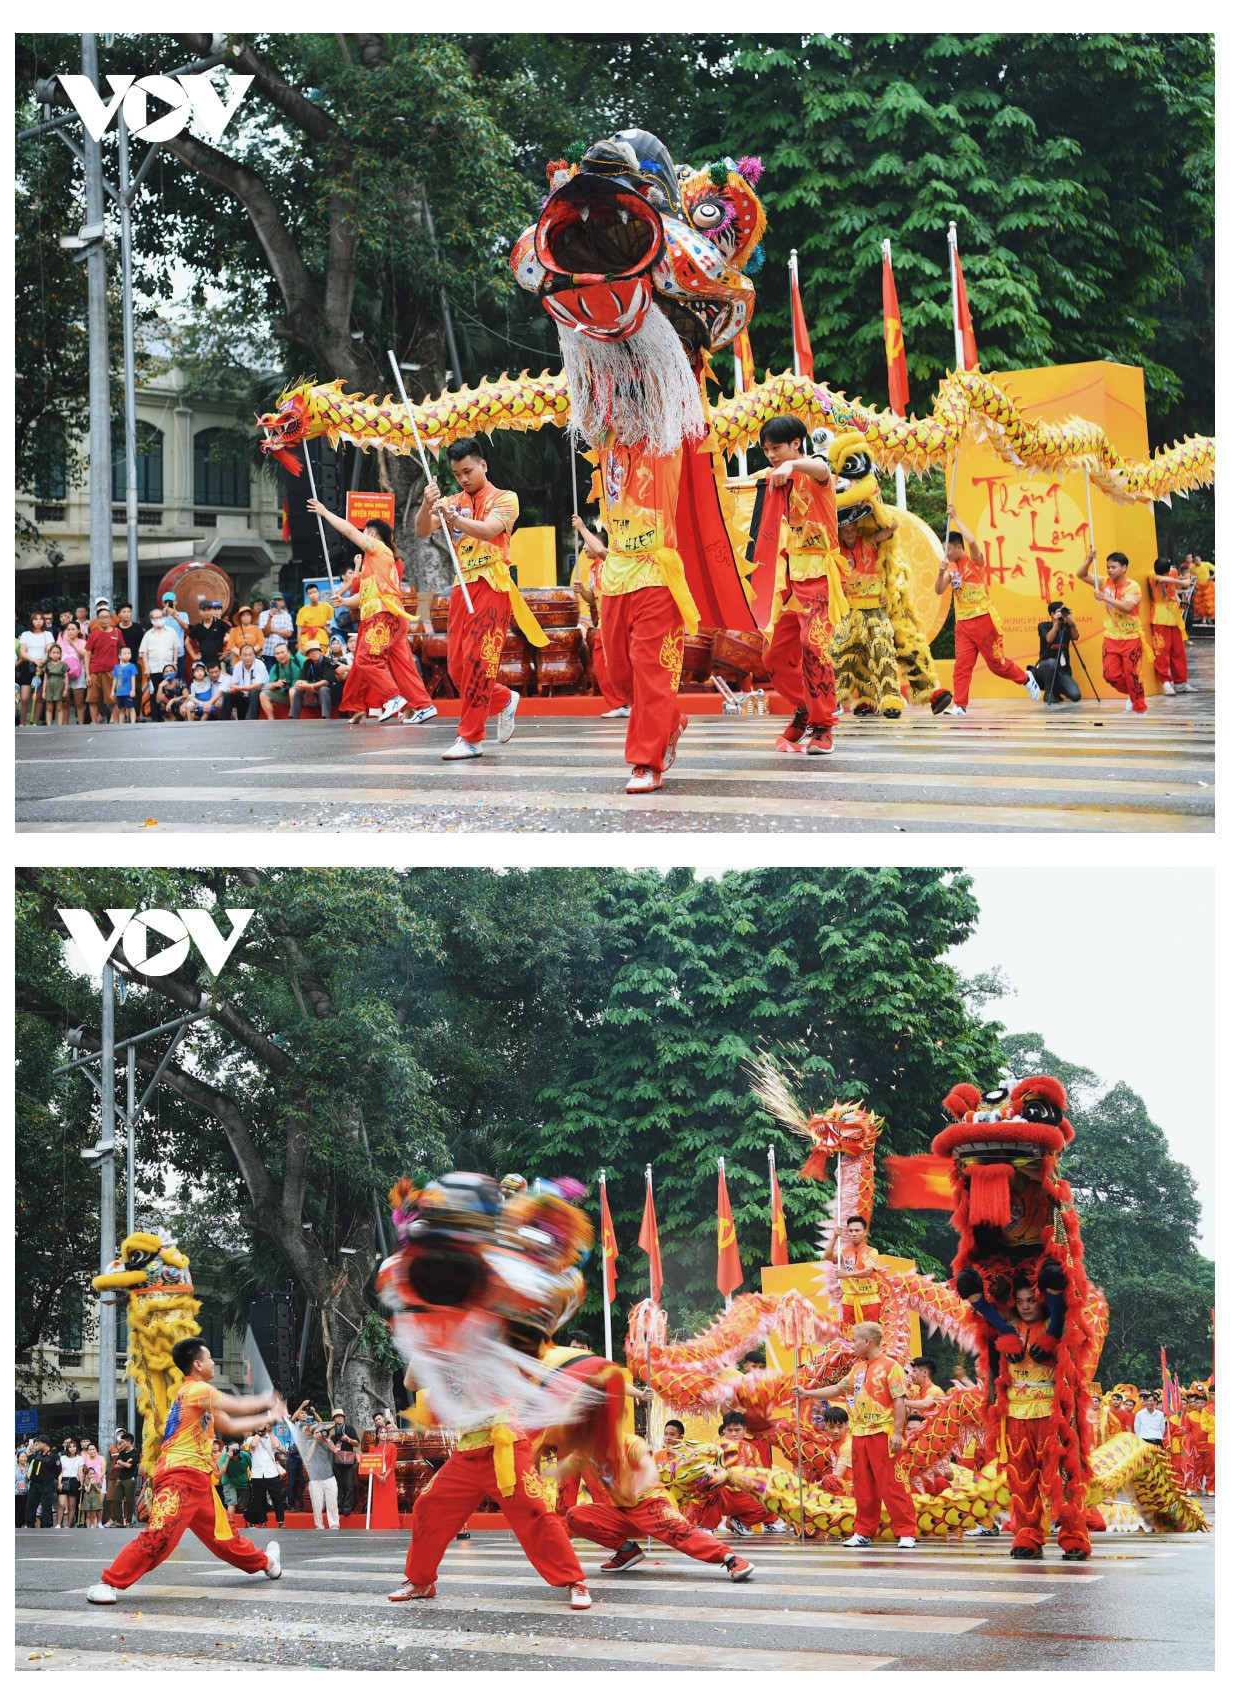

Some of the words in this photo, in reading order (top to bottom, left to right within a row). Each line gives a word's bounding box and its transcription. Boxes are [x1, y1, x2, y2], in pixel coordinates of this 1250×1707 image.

[972, 475, 1060, 529] Thăng
[1029, 511, 1089, 561] Long
[983, 535, 1027, 587] Hà
[1035, 556, 1075, 605] Nội
